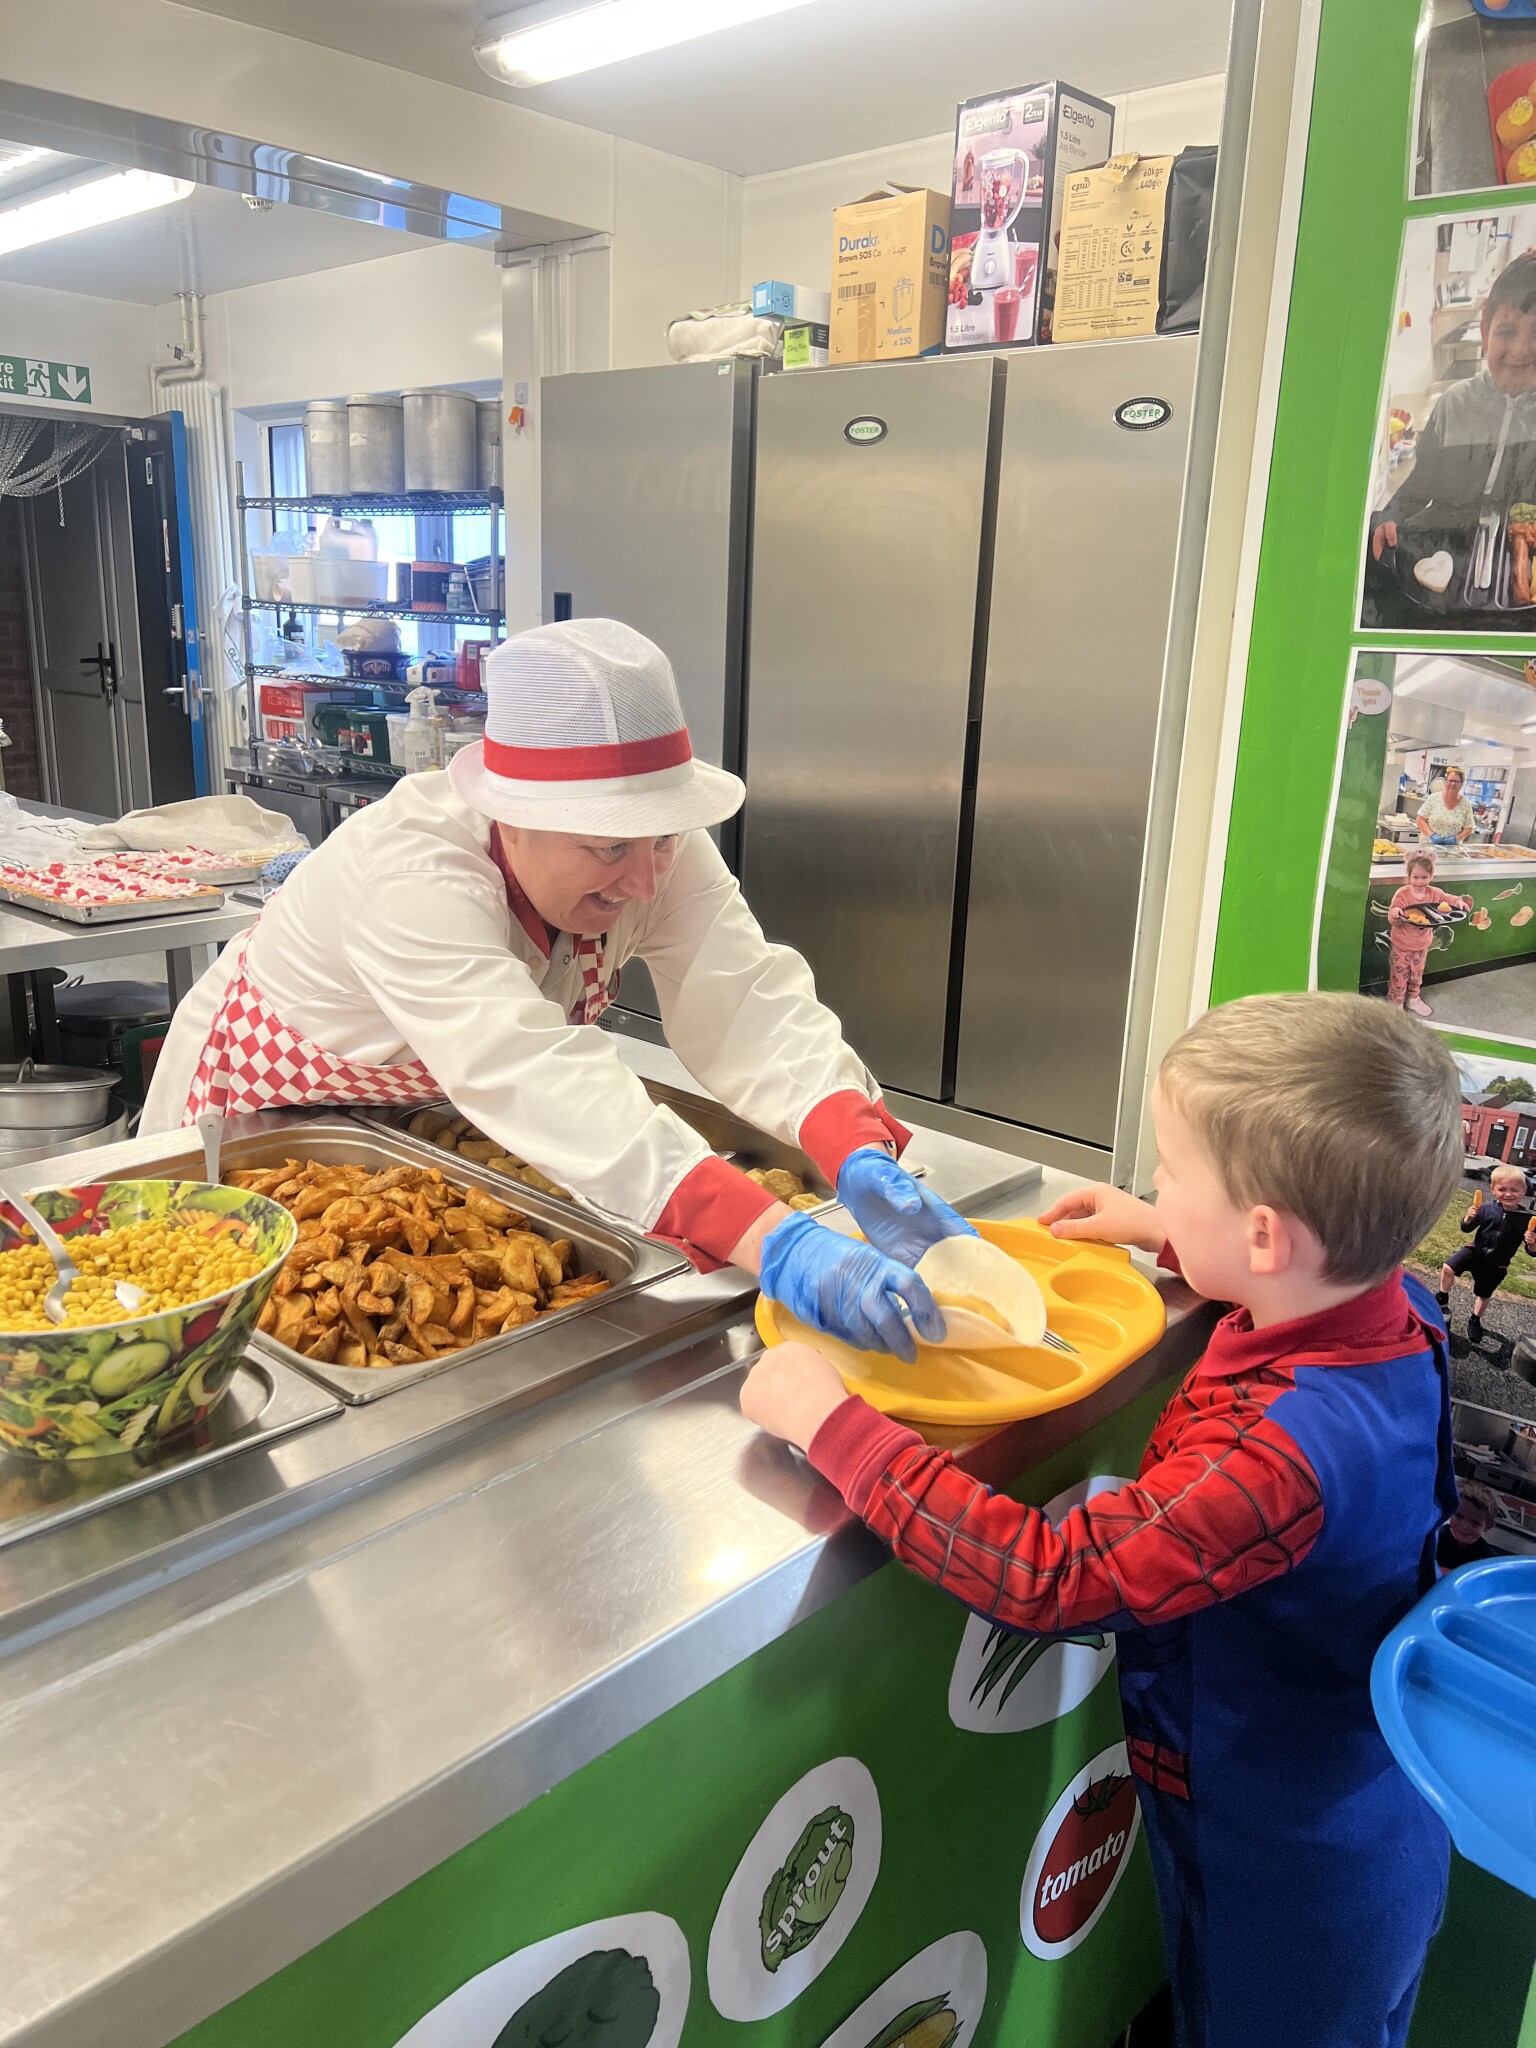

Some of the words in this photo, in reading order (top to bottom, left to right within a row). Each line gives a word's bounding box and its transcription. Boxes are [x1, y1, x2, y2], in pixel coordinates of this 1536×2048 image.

[964, 111, 1007, 131] Elgento
[1062, 104, 1095, 129] Elgento
[1060, 130, 1069, 141] 1.5
[1069, 133, 1081, 146] Litre
[1059, 142, 1069, 154] Jug
[1069, 144, 1087, 158] Blender
[838, 254, 859, 264] Brown
[858, 250, 872, 260] SOS
[929, 256, 948, 270] Brow
[886, 325, 912, 336] Medium
[950, 325, 959, 333] 1.5
[960, 325, 975, 333] Litre
[899, 336, 912, 346] 250
[949, 335, 960, 343] Jug
[961, 333, 984, 341] Blender
[1123, 408, 1161, 419] FOSTER
[850, 426, 880, 434] FOSTER
[1357, 687, 1381, 697] Thank
[1362, 699, 1377, 707] you
[1040, 1829, 1126, 1910] tomato
[765, 1818, 847, 1954] sprout
